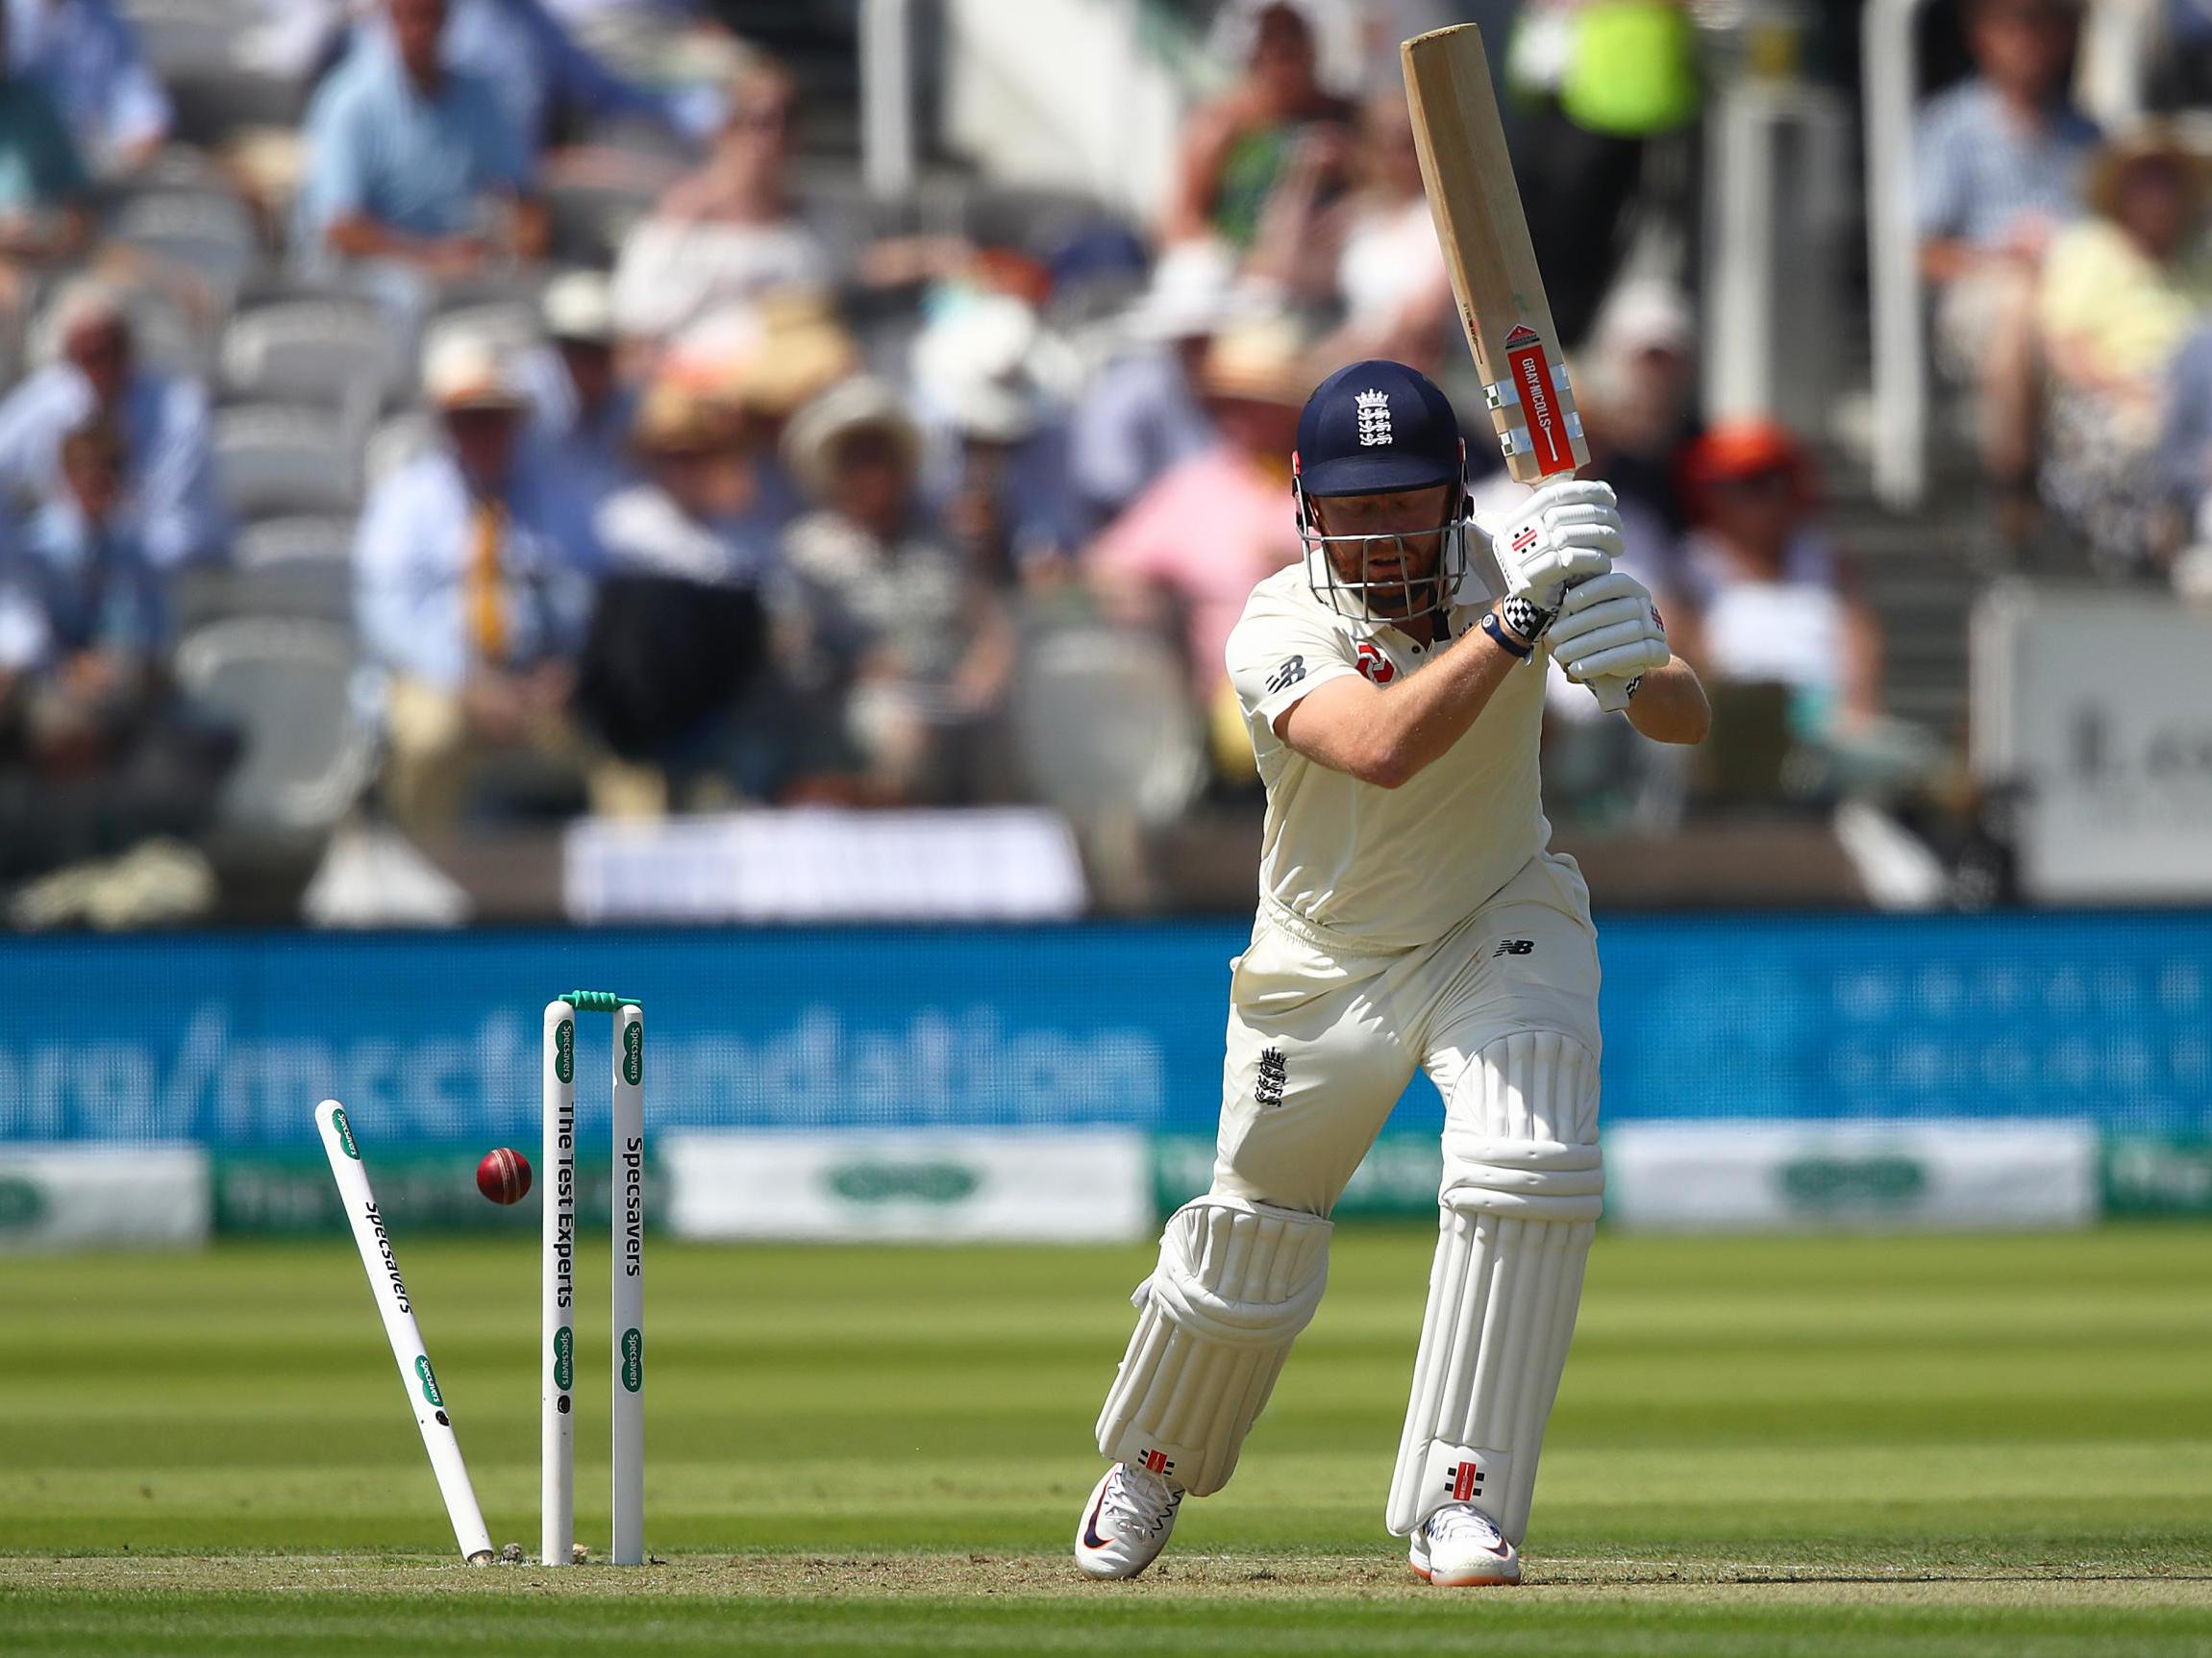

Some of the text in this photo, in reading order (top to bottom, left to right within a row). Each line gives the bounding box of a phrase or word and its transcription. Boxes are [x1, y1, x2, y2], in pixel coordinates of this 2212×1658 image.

[1522, 358, 1551, 429] GRAY-NICOLLS
[561, 1026, 571, 1077] Specsavers
[631, 1027, 639, 1079] Specsavers
[554, 1101, 574, 1308] The Test Experts
[623, 1137, 642, 1276] Specsavers
[365, 1201, 412, 1314] Specsavers
[420, 1359, 440, 1402] Specsavers
[560, 1332, 570, 1384] Specsavers
[628, 1334, 638, 1386] Specsavers
